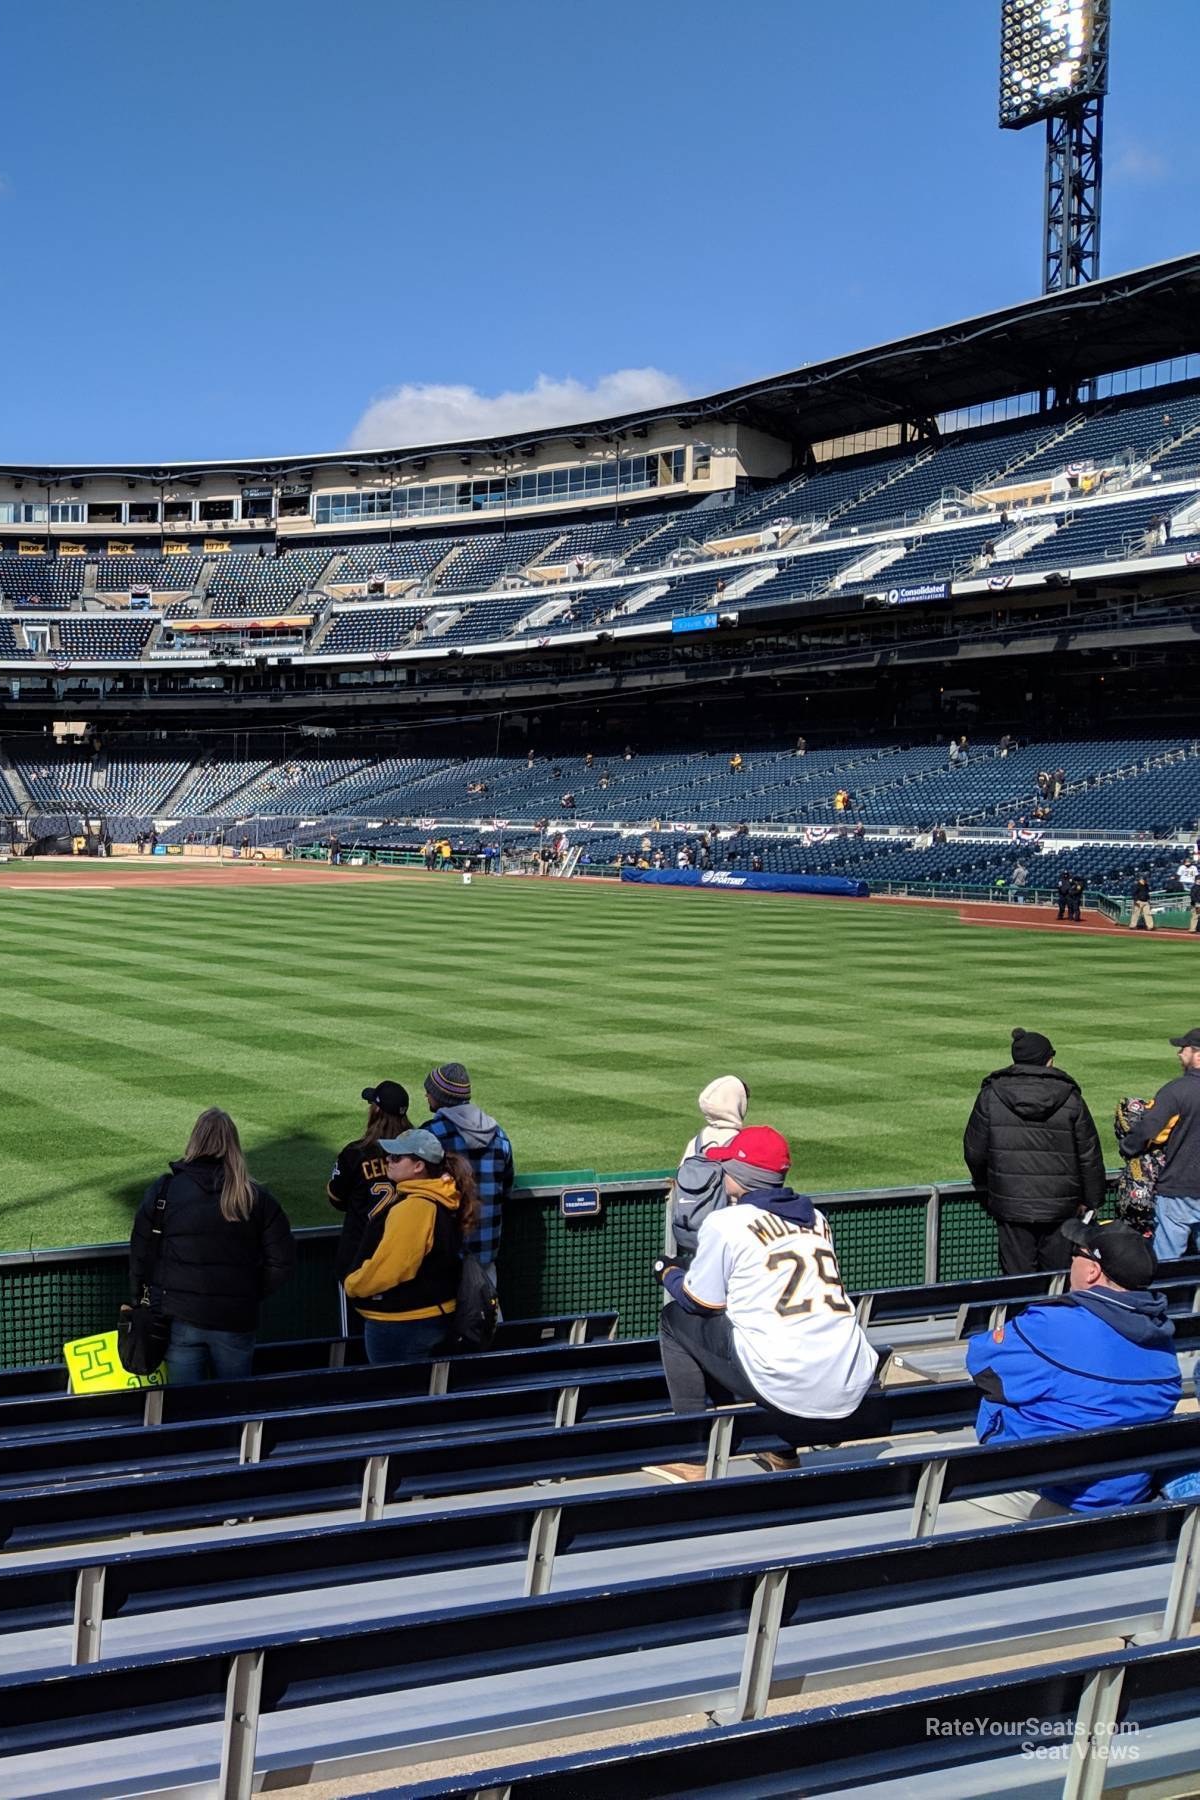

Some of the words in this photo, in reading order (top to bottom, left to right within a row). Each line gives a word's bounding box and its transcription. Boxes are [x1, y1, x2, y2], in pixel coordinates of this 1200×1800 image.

[900, 583, 945, 597] Consolidated
[73, 836, 86, 855] P
[766, 1247, 852, 1317] 29
